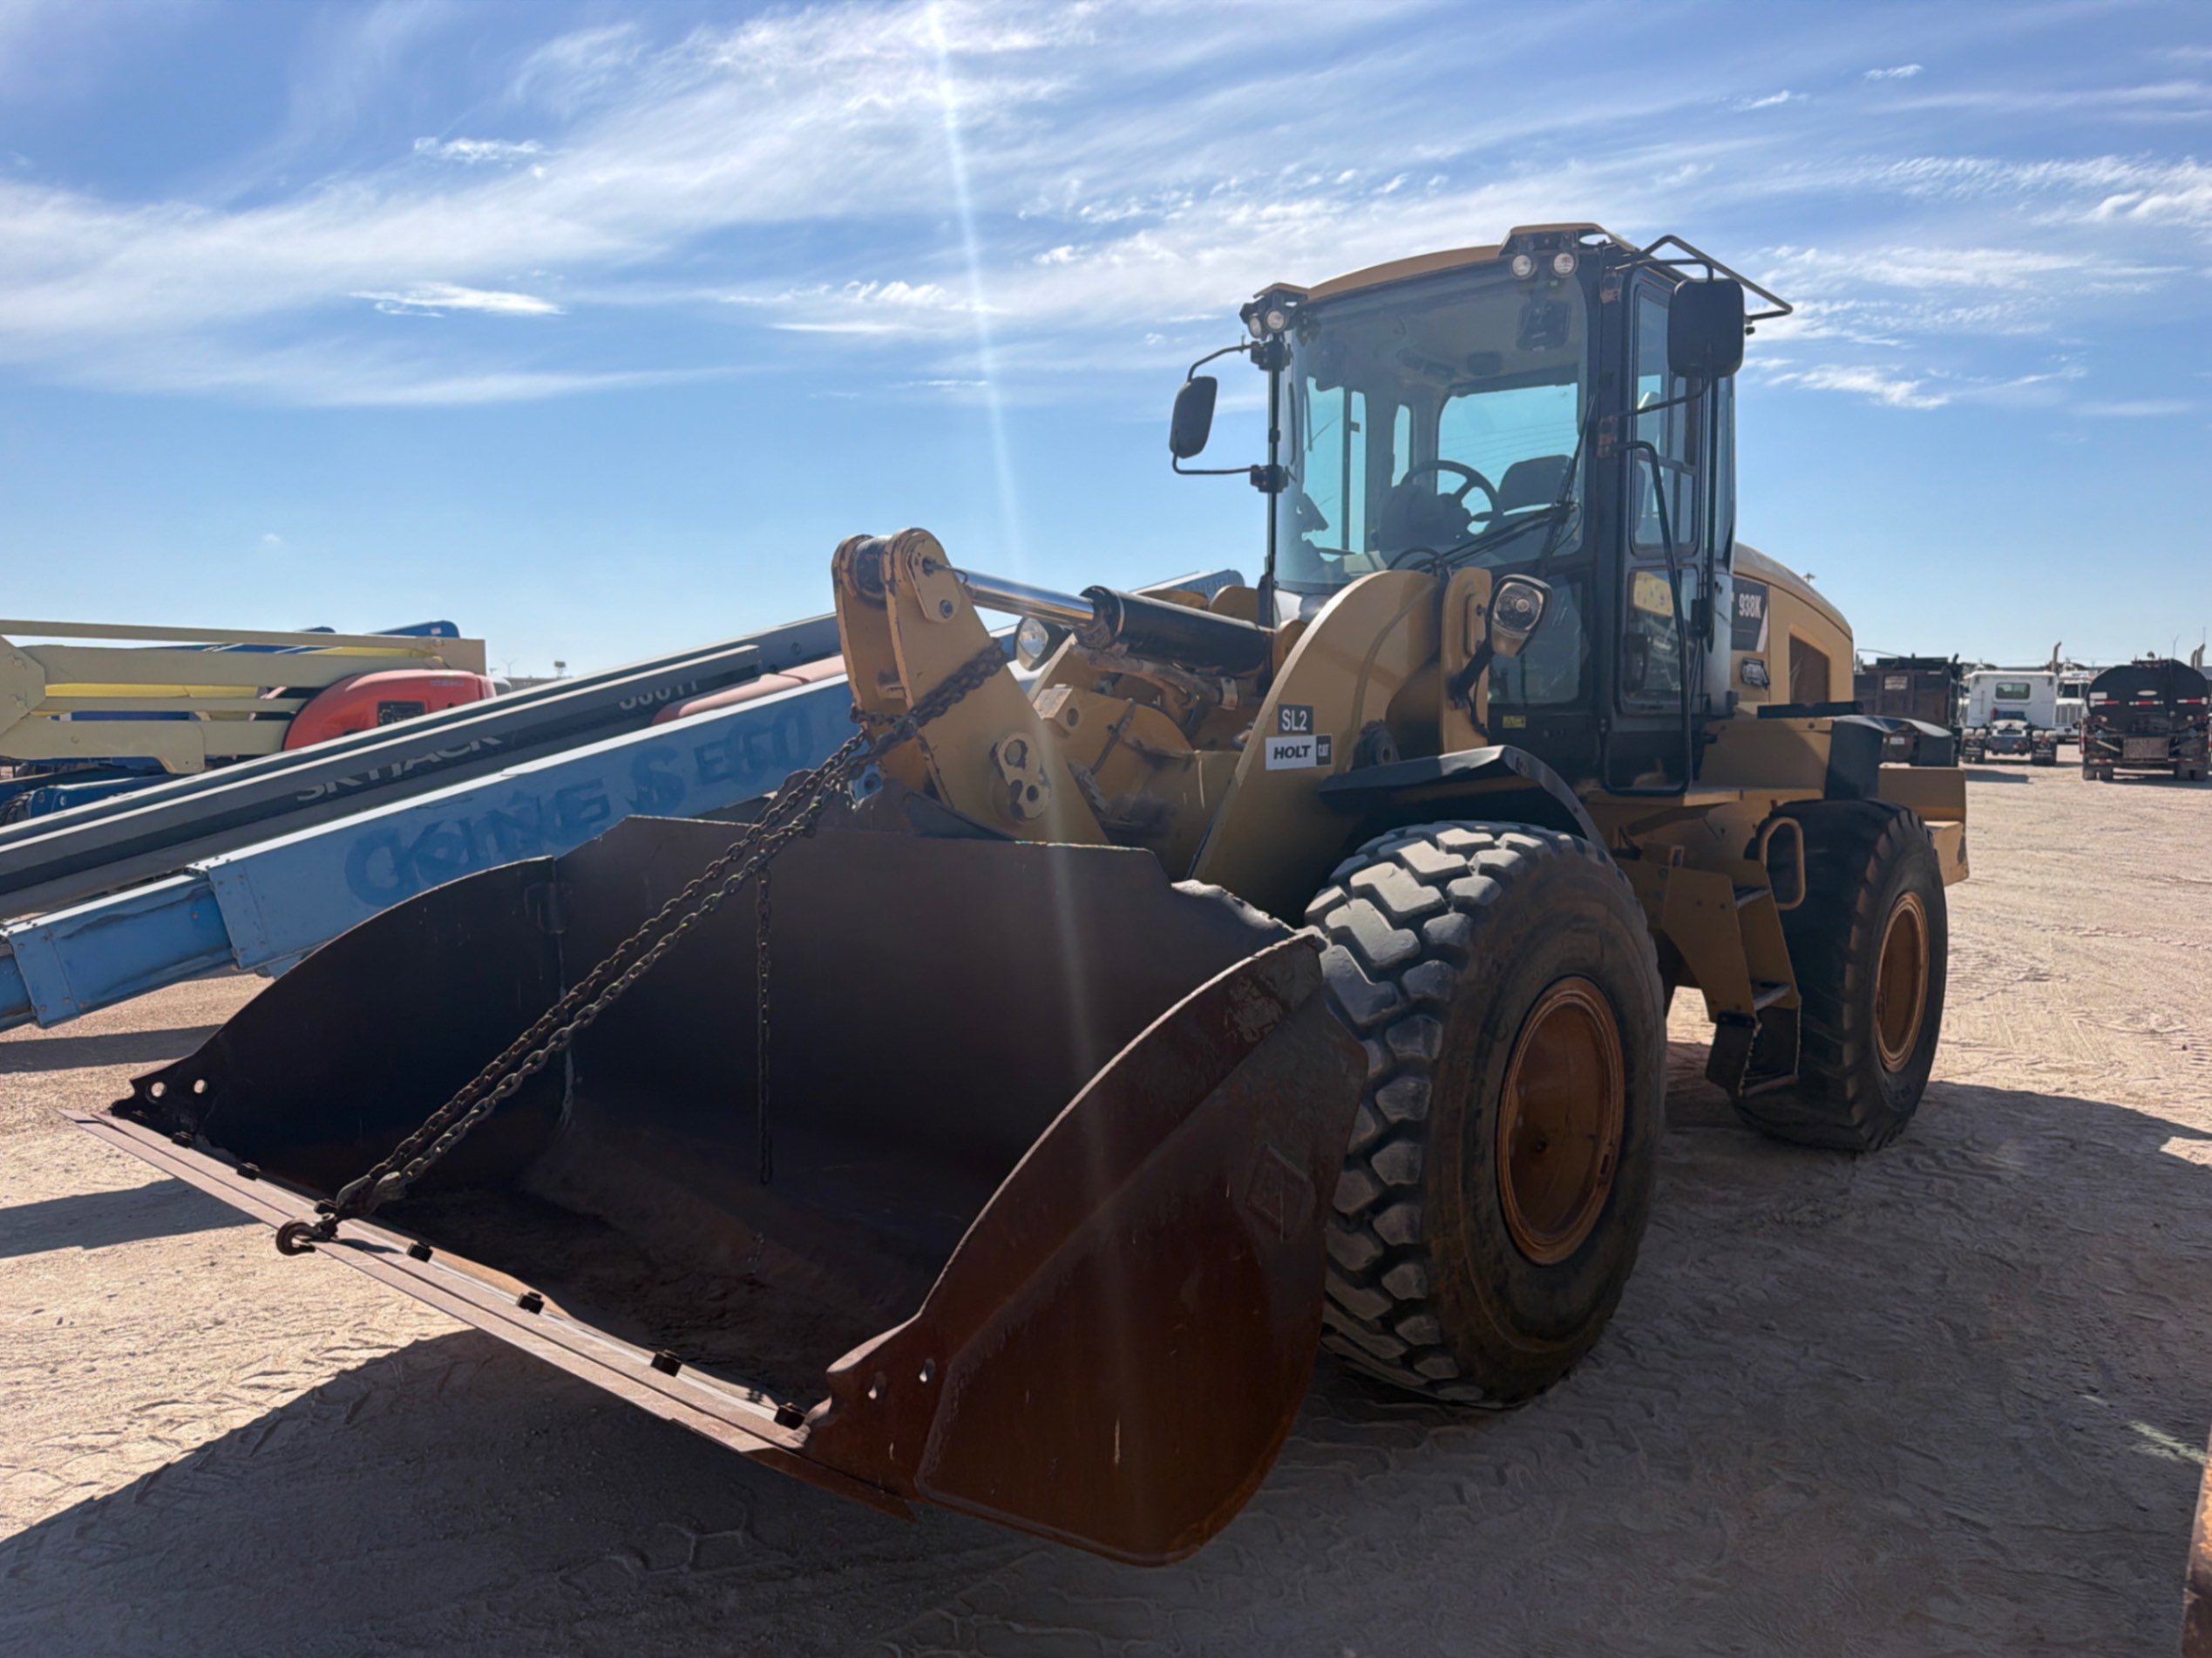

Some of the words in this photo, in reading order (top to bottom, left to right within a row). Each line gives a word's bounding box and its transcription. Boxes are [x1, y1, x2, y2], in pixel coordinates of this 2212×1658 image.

[1739, 593, 1761, 619] 938K
[1281, 709, 1308, 731] SL2
[1273, 745, 1311, 760] HOLT
